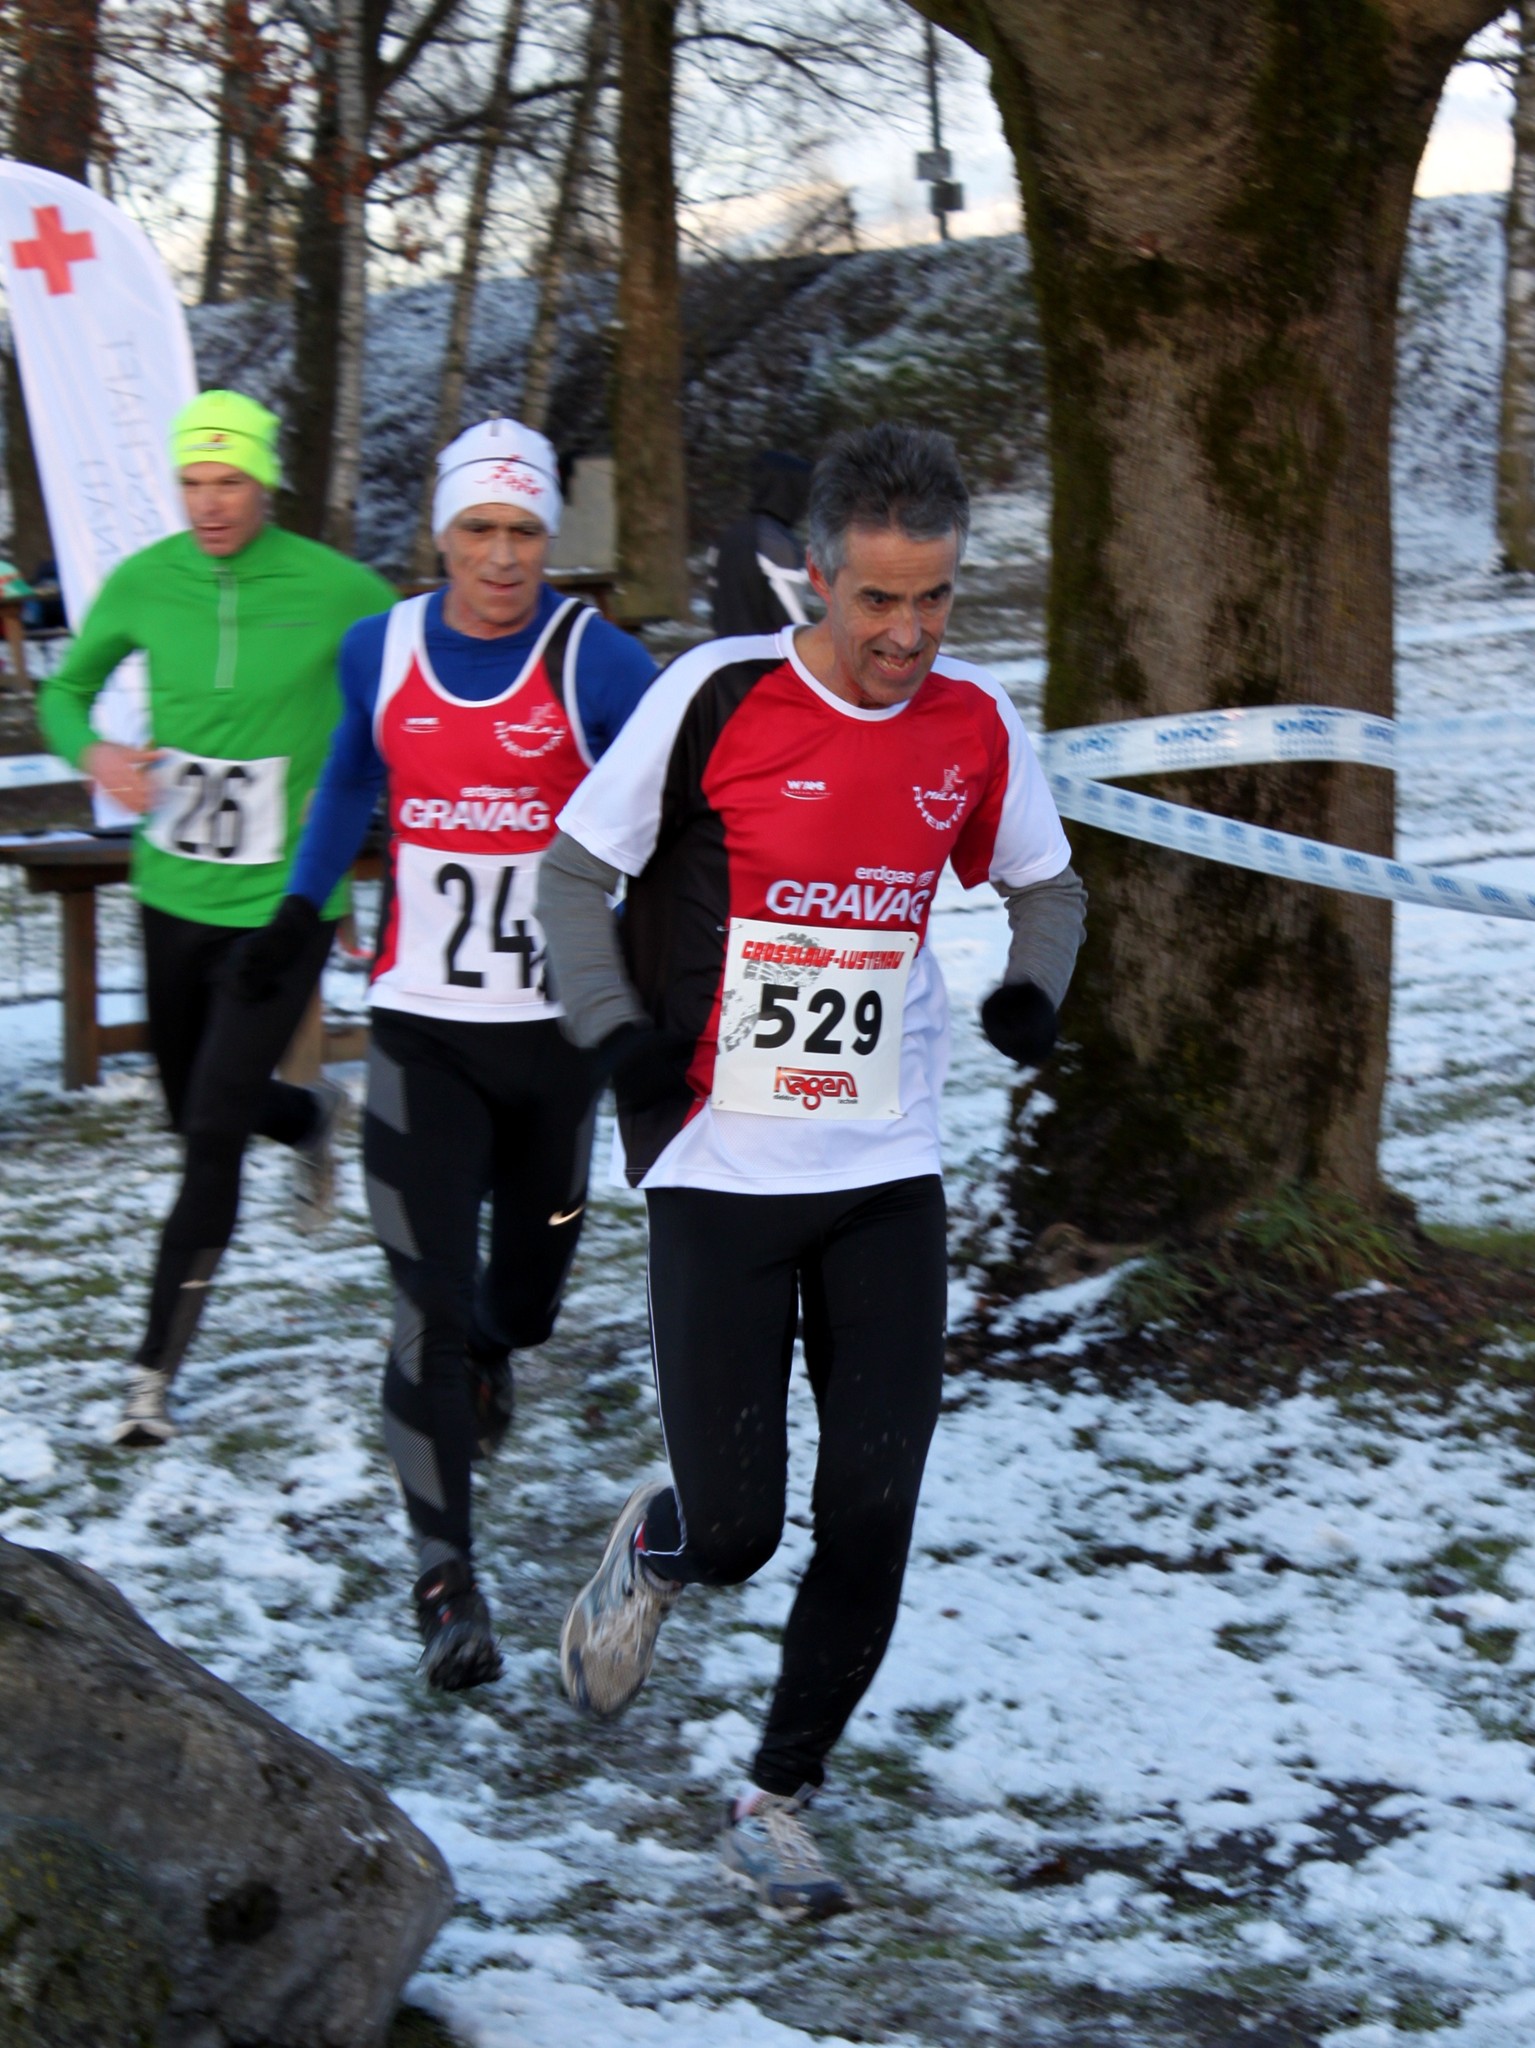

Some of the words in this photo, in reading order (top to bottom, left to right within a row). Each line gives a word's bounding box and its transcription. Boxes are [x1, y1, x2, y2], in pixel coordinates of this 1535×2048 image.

[170, 762, 256, 858] 26
[399, 798, 551, 832] GRAVAG
[766, 880, 932, 924] GRAVAG
[855, 865, 915, 885] erdgas
[436, 862, 535, 988] 24
[753, 983, 884, 1056] 529
